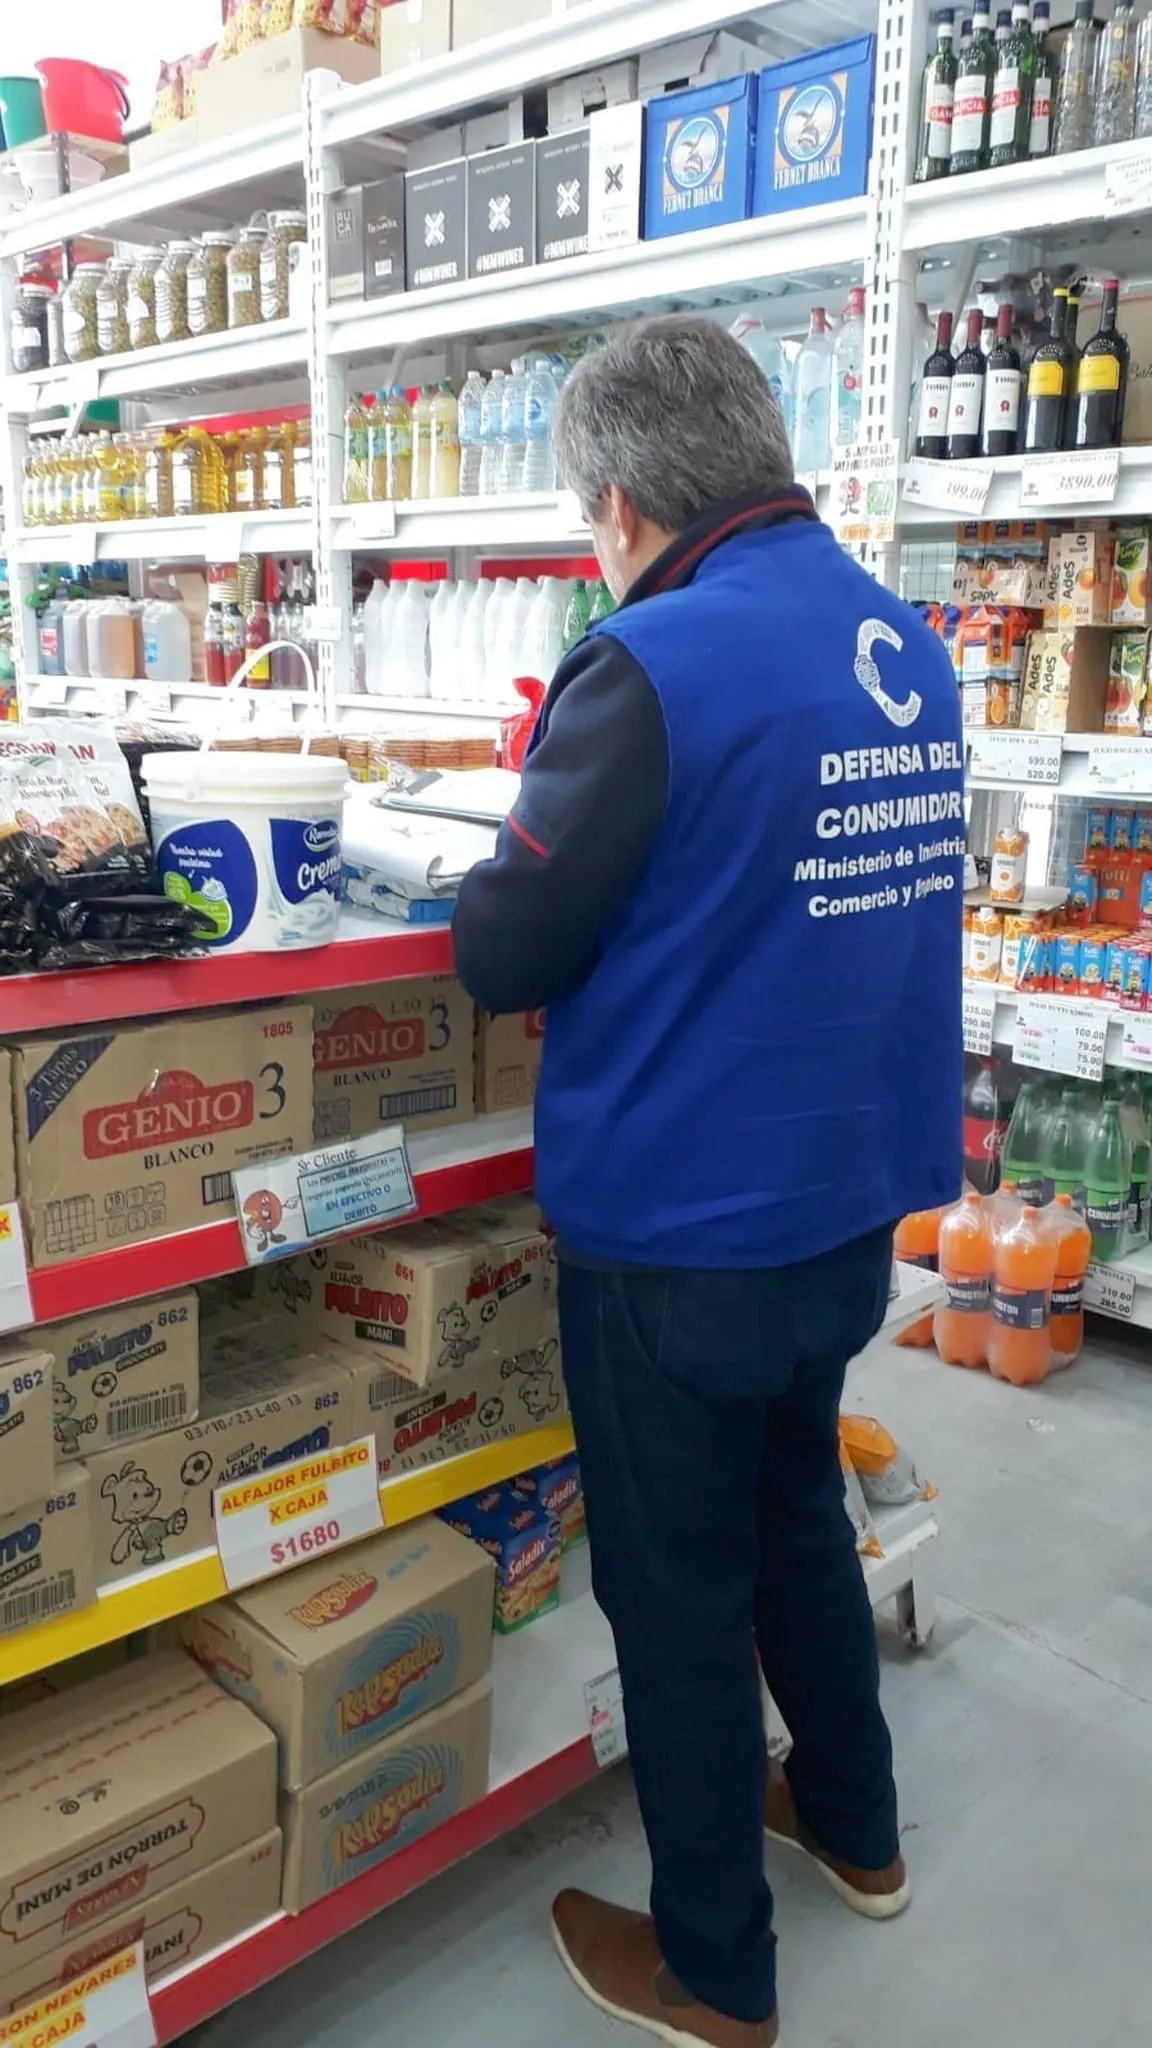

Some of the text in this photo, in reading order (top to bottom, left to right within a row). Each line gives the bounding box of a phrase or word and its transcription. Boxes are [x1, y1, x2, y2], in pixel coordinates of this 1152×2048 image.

[774, 156, 841, 191] FERNET BRANCA
[663, 183, 723, 216] FERNET BRANCA
[1047, 563, 1061, 601] AdeS
[1063, 560, 1075, 599] AdeS
[1028, 654, 1042, 690] AdeS
[1042, 656, 1057, 693] AdeS
[821, 741, 962, 786] DEFENSA DEL
[1027, 770, 1058, 780] 520.00
[1028, 756, 1059, 766] 599.00
[816, 791, 963, 839] CONSUMIDOR
[793, 852, 892, 882] Ministerio
[895, 846, 913, 867] de
[808, 886, 898, 918] Comercio
[902, 886, 912, 907] y
[262, 1021, 294, 1039] 1805
[429, 1003, 451, 1051] 3
[259, 1061, 287, 1119] 3
[333, 1067, 392, 1087] BLANCO
[96, 1088, 244, 1146] GENIO
[143, 1141, 214, 1170] BLANCO
[313, 1148, 357, 1168] Cliente
[326, 1183, 391, 1211] EN EFECTIVO O
[395, 1262, 414, 1281] 861
[523, 1246, 544, 1264] 861
[157, 1307, 189, 1327] 862
[325, 1282, 408, 1325] FULBITO
[68, 1323, 153, 1377] FULBITO
[12, 1369, 44, 1394] 862
[314, 1391, 340, 1411] 862
[184, 1409, 253, 1441] 03/10/23
[218, 1445, 269, 1483] ALFAJOR
[221, 1448, 370, 1513] ALFAJOR FULBITO
[46, 1492, 77, 1514] 862
[270, 1489, 329, 1522] X CAJA
[270, 1519, 341, 1565] $1680
[508, 1537, 547, 1582] Saladix
[338, 1634, 443, 1735] Rapsodia
[333, 1764, 443, 1868] Rapsodia
[77, 1862, 103, 1885] DE
[45, 1955, 137, 2014] NEVARES
[32, 2010, 86, 2048] CAJA
